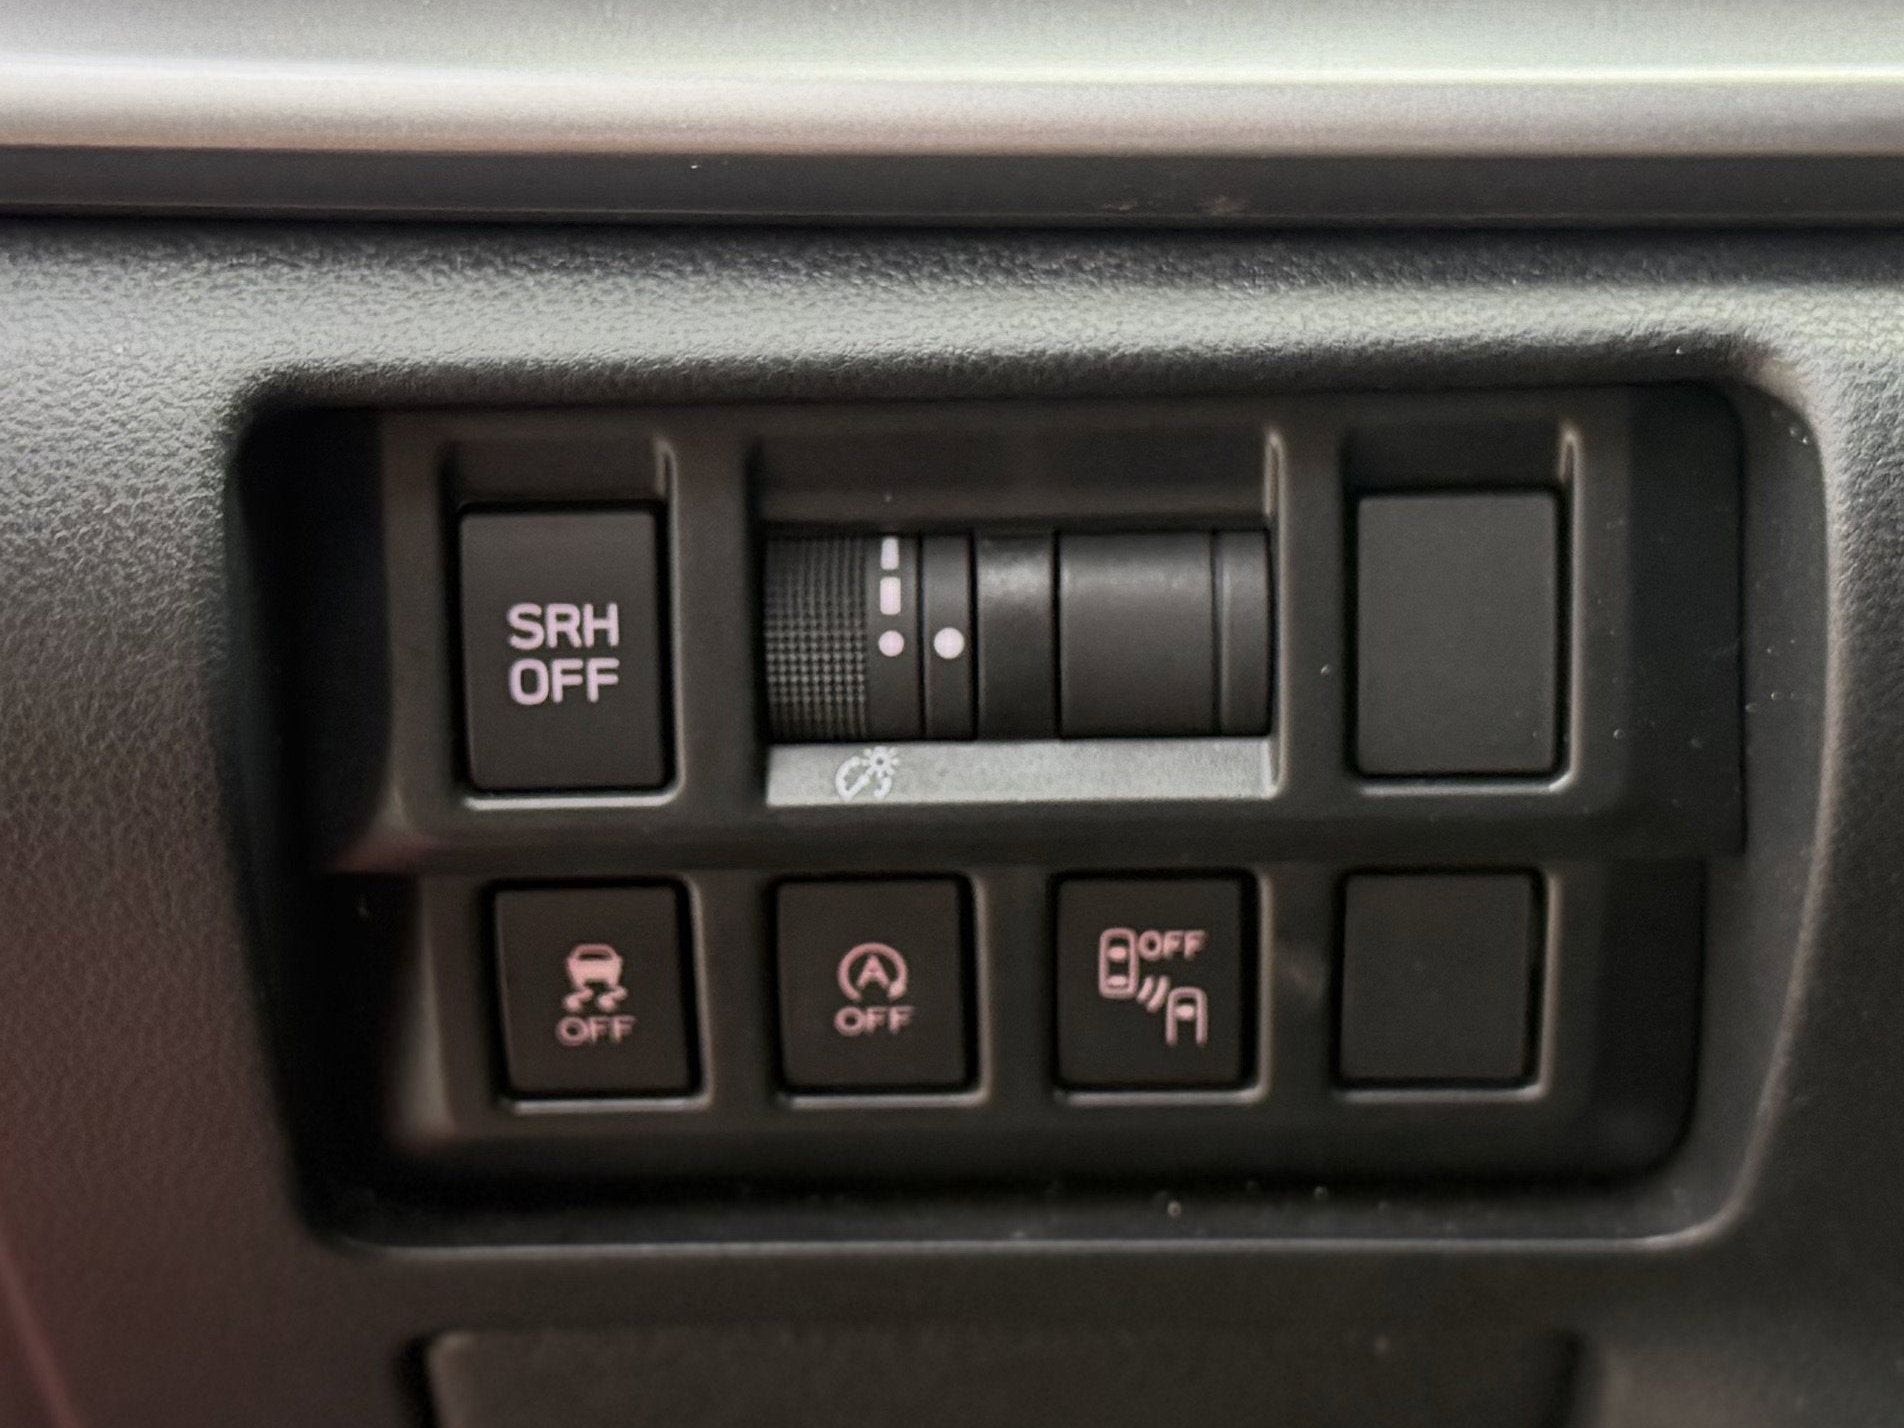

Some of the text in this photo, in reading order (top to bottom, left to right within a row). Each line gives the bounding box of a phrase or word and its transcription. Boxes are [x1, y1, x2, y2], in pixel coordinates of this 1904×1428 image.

[507, 602, 620, 650] SRH
[509, 657, 620, 706] OFF
[1138, 929, 1208, 961] OFF
[556, 1015, 638, 1047] OFF
[834, 1006, 914, 1037] OFF
